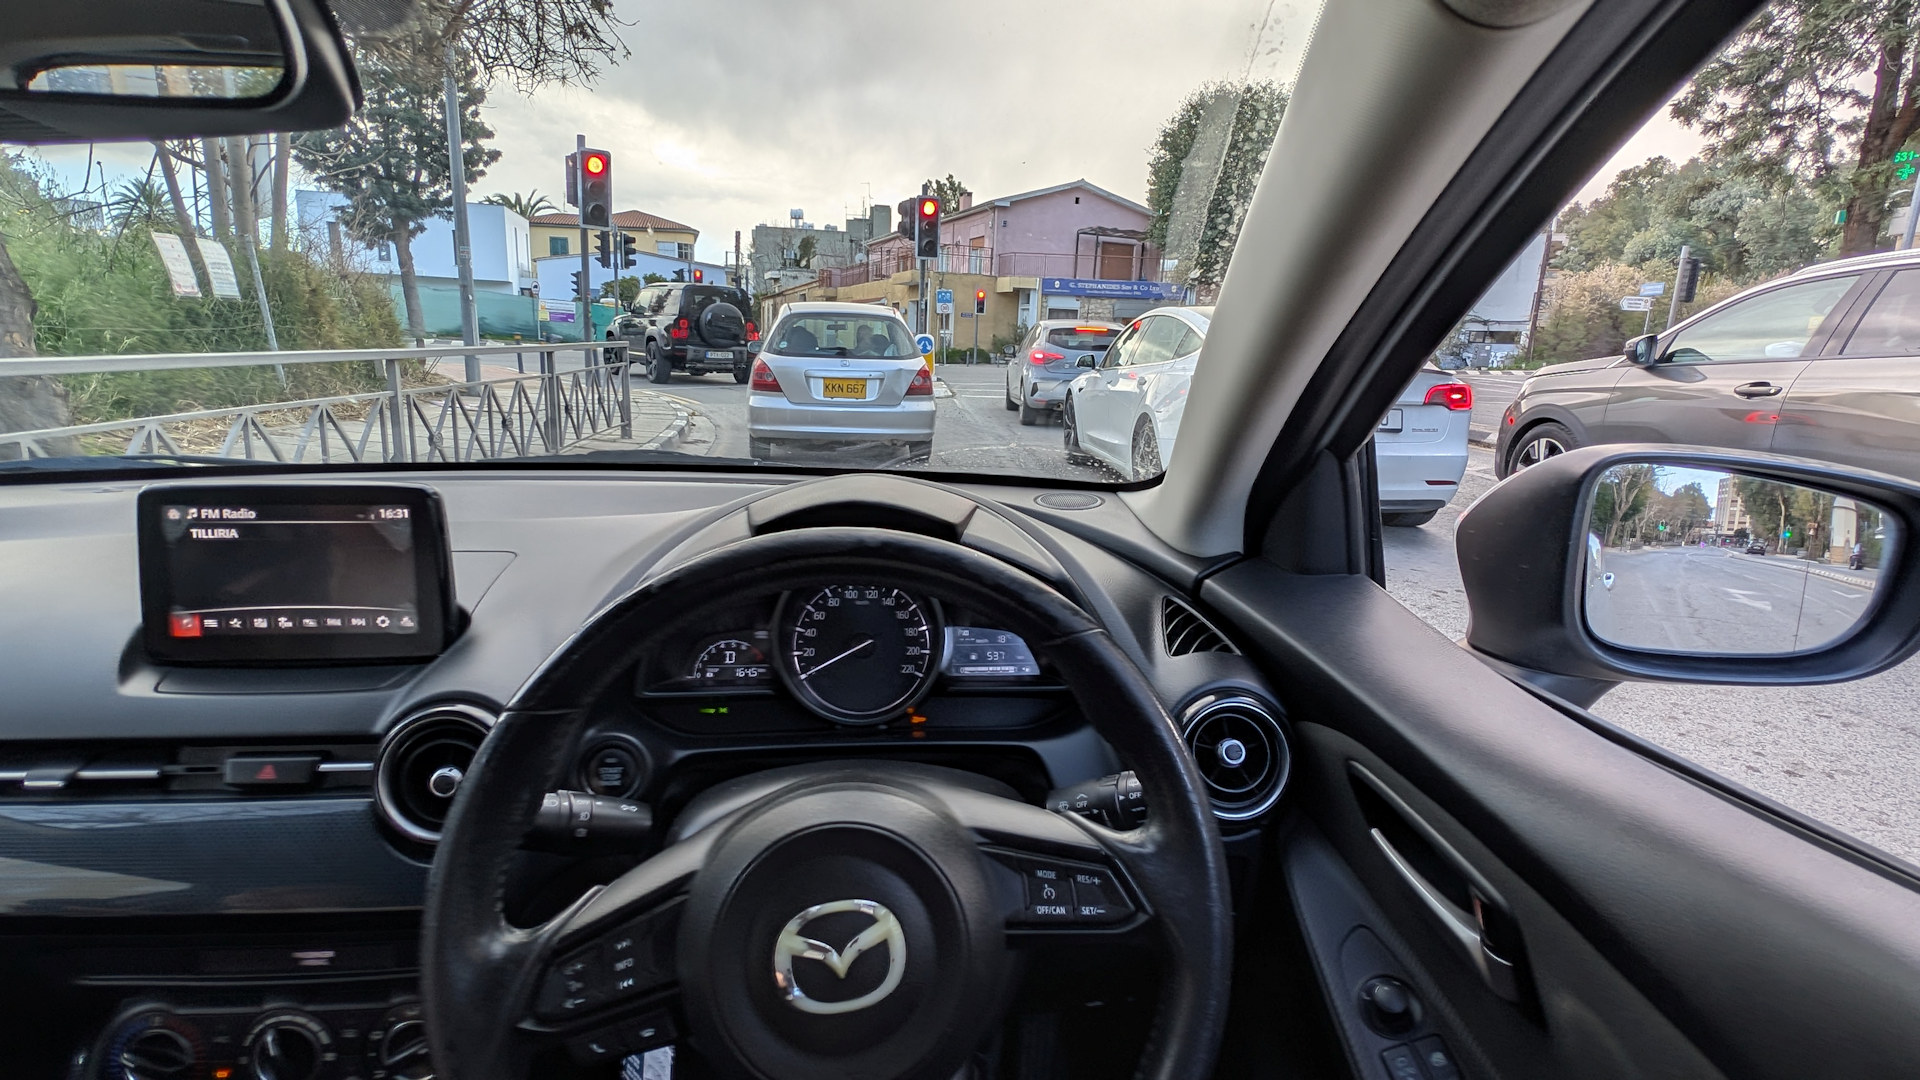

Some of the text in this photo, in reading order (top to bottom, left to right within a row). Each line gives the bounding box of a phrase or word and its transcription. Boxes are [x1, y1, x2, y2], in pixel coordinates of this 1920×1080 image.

[825, 383, 865, 394] KKN 667
[201, 508, 256, 519] FM Radio
[379, 508, 409, 519] 16:31
[190, 529, 239, 538] TILLIRIA
[844, 590, 858, 599] 100
[865, 590, 879, 599] 120
[828, 598, 840, 607] 80
[882, 597, 896, 606] 140
[813, 611, 826, 620] 60
[896, 610, 910, 620] 160
[804, 628, 816, 637] 40
[905, 628, 918, 636] 180
[803, 648, 815, 657] 20
[906, 646, 920, 655] 200
[724, 651, 736, 664] D
[986, 651, 1006, 661] 537
[901, 664, 915, 674] 220
[1128, 791, 1142, 800] OFF
[1076, 801, 1088, 809] OFF
[1036, 869, 1057, 880] MODE
[1036, 905, 1066, 915] OFF/CAN
